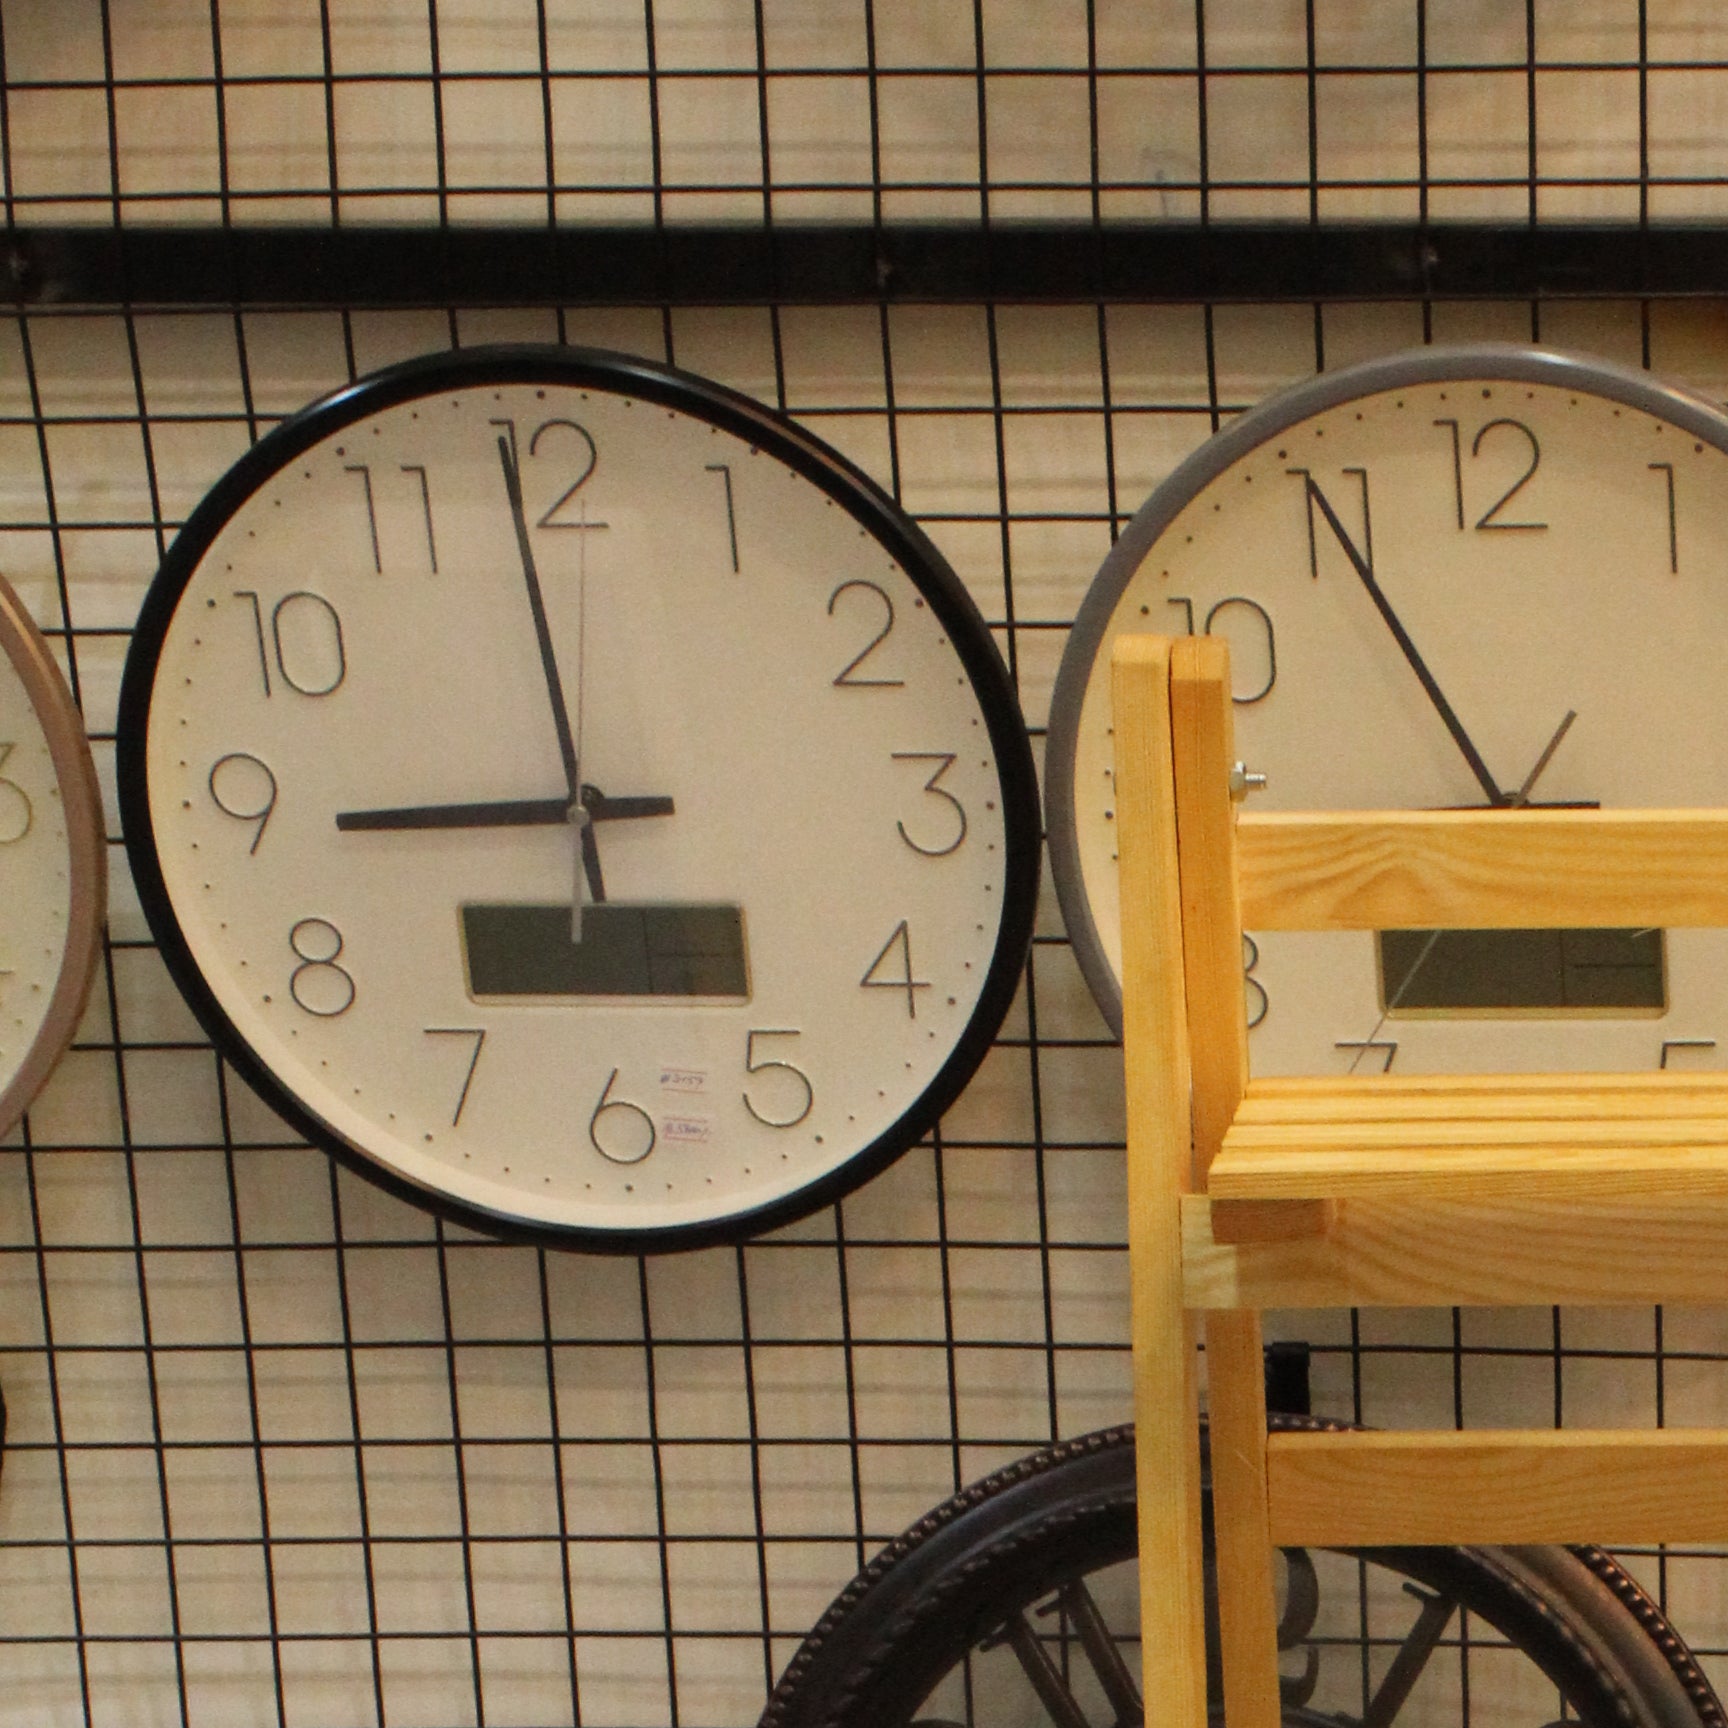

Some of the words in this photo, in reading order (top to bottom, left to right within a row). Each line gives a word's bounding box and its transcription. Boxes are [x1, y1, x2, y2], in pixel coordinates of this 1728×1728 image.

[345, 466, 438, 575] 11
[490, 418, 610, 529] 12
[706, 466, 740, 574] 1
[1286, 469, 1376, 578] 11
[1433, 418, 1549, 530] 12
[1648, 463, 1677, 574] 1
[233, 591, 346, 699] 10
[829, 580, 906, 687] 2
[209, 753, 278, 856] 9
[891, 753, 968, 857] 3
[289, 918, 357, 1018] 8
[860, 920, 932, 1020] 4
[424, 1029, 486, 1127] 7
[591, 1068, 656, 1165] 6
[743, 1030, 814, 1128] 5
